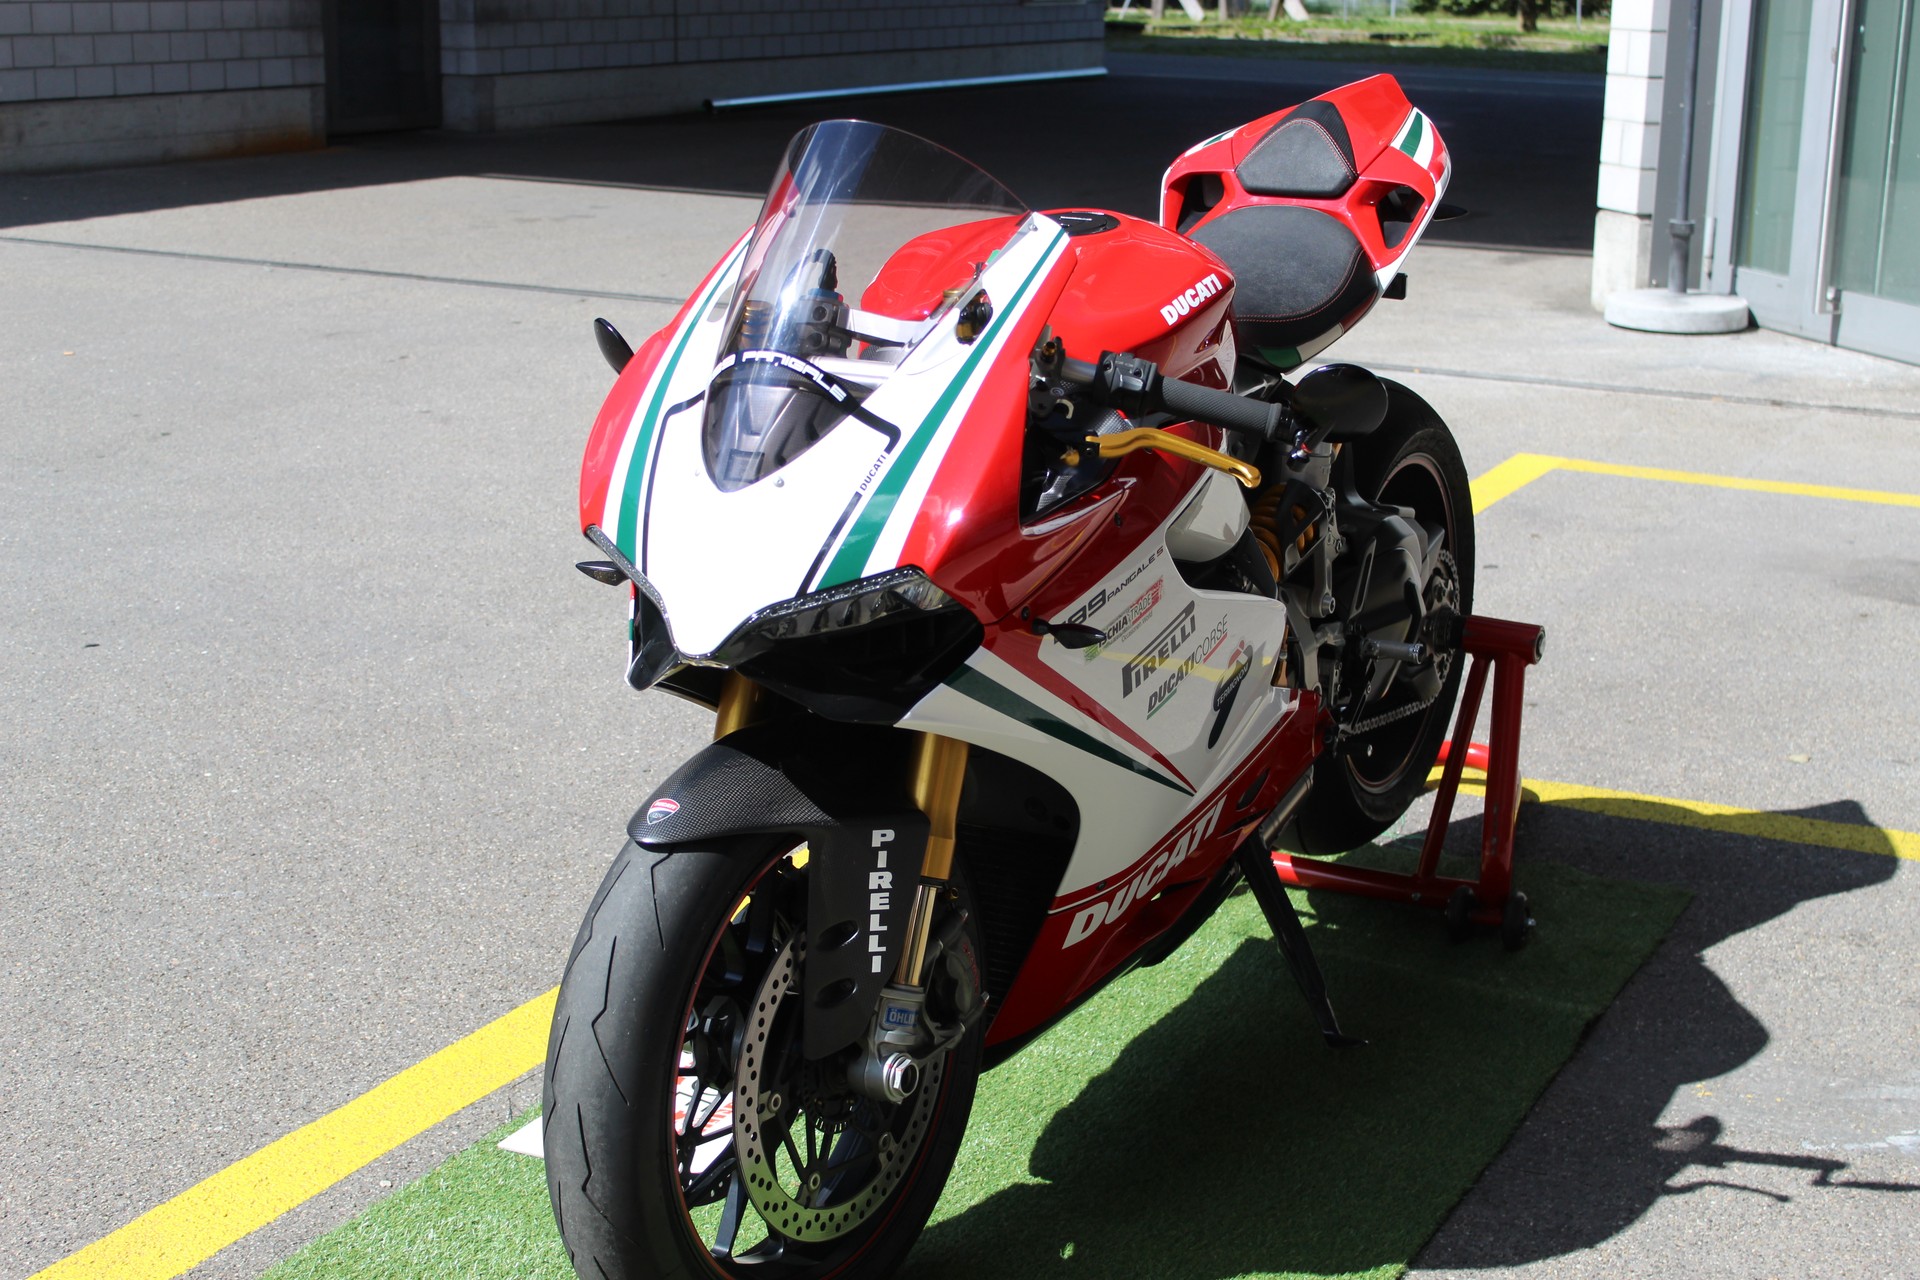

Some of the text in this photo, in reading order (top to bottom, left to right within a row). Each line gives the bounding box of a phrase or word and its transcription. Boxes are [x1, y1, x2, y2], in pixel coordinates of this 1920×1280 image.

[1160, 273, 1223, 326] DUCATI
[742, 350, 848, 402] PANIGALE
[860, 455, 887, 492] DUCATI
[1107, 554, 1156, 602] PANIGALE
[1157, 545, 1164, 558] S
[1122, 600, 1196, 699] PIRELLI
[1062, 794, 1227, 950] DUCATI
[868, 829, 895, 973] PIRELLI
